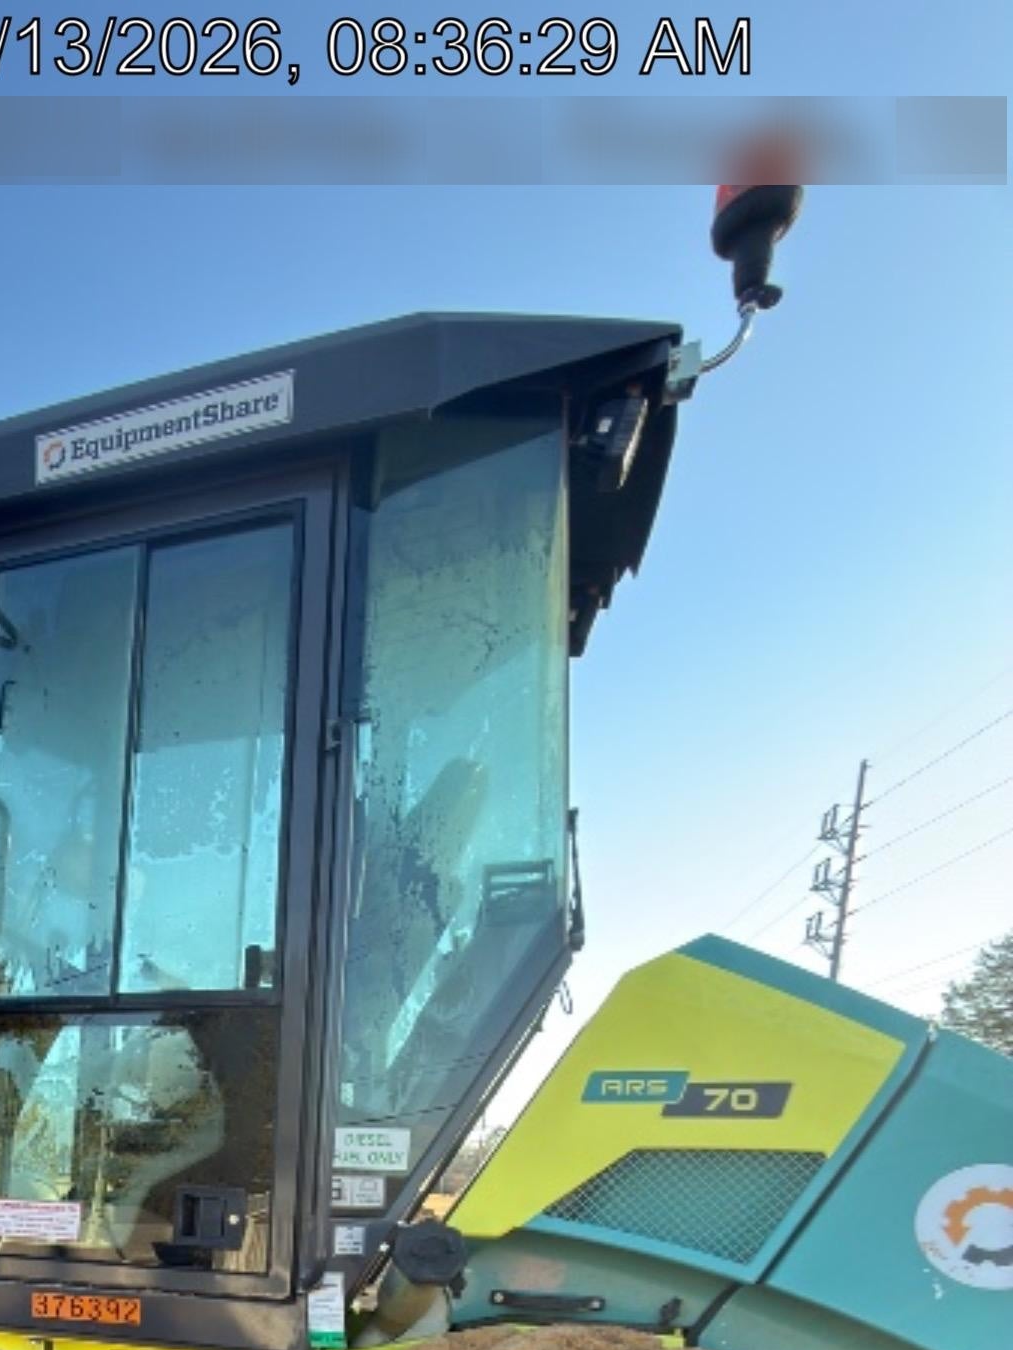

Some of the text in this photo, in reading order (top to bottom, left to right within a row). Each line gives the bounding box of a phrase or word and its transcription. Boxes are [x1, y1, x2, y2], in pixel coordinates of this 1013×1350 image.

[70, 391, 279, 460] EquipmentShare
[601, 1079, 758, 1111] ARS 70
[367, 1151, 405, 1165] ONLY
[34, 1295, 138, 1323] 376392
